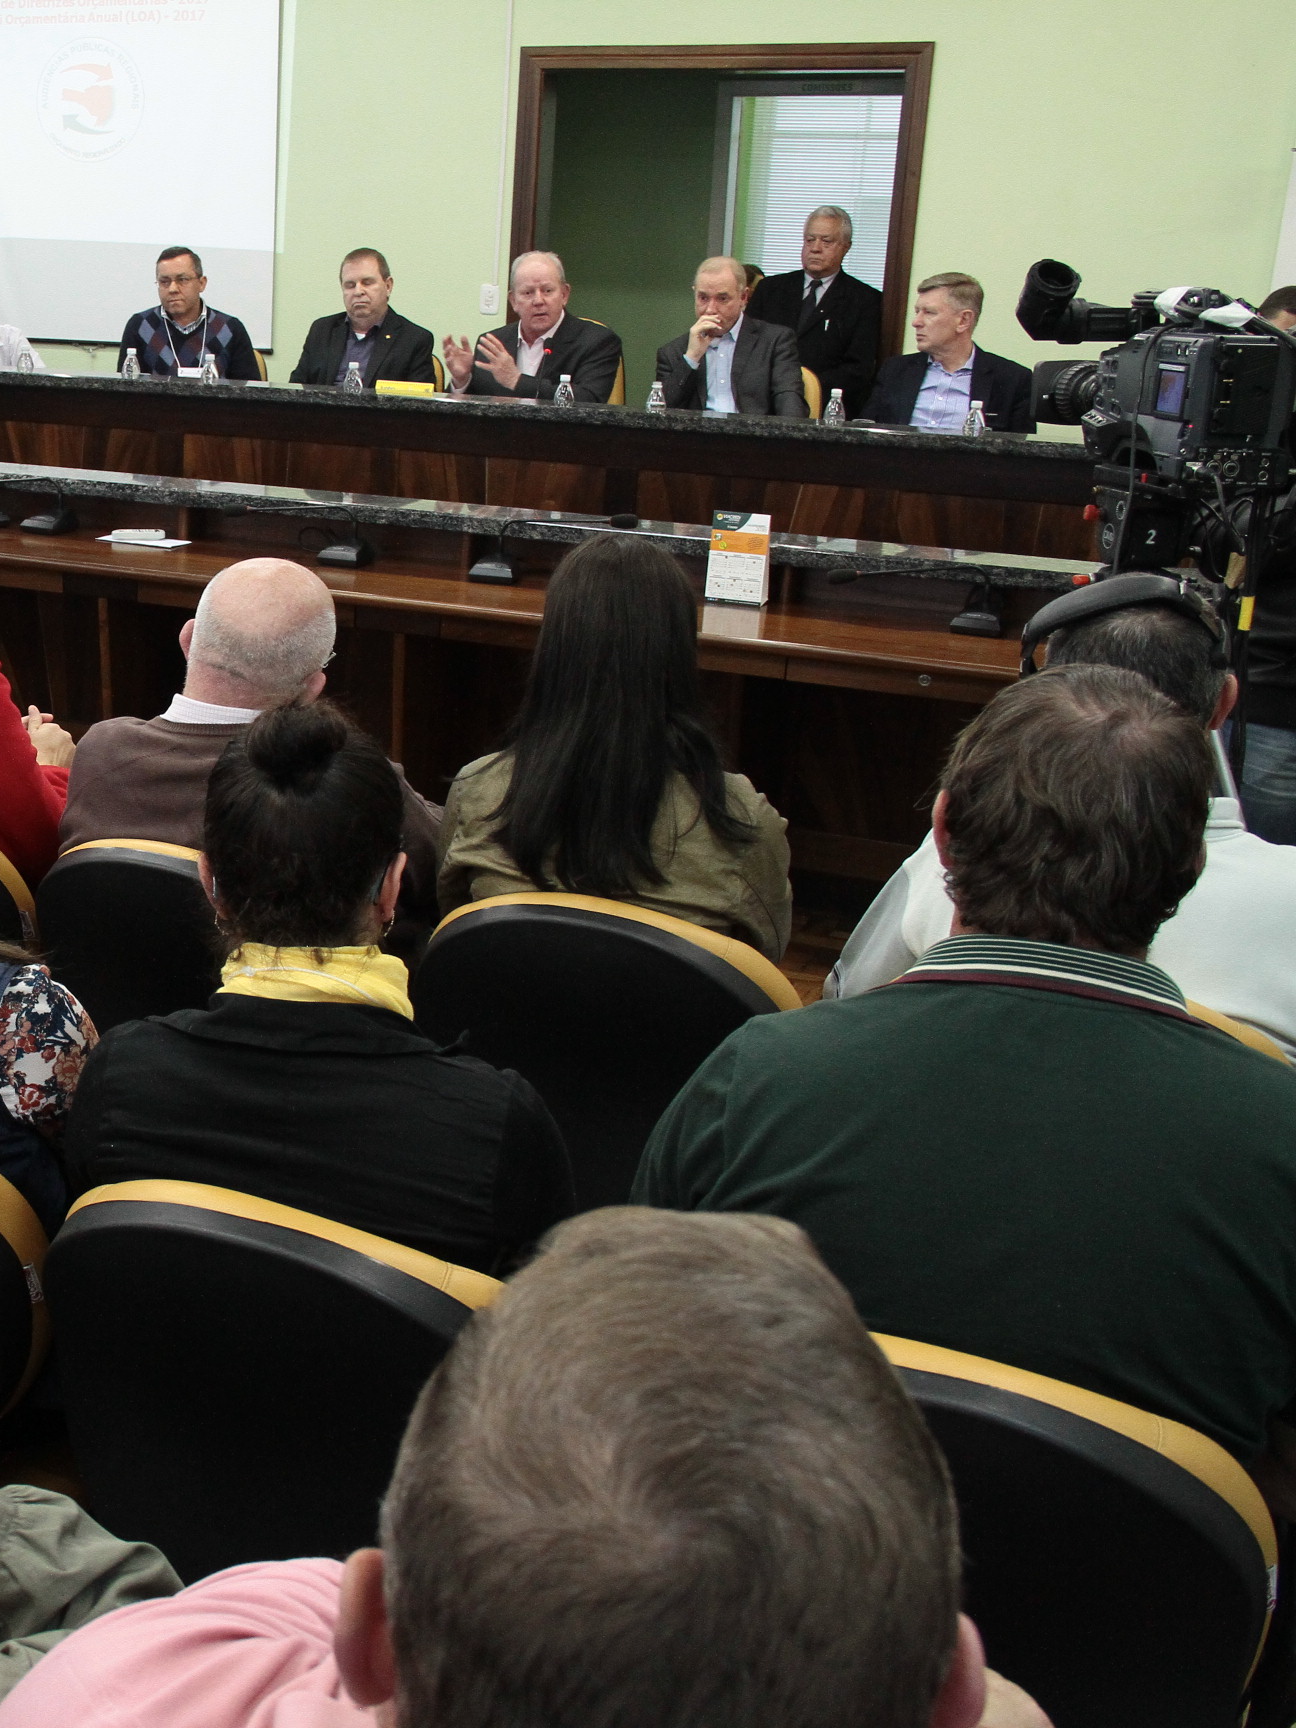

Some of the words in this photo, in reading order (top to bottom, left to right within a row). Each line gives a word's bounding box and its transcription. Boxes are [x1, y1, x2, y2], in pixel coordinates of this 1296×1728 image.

[88, 10, 123, 23] Anual
[125, 9, 161, 25] (LOA)
[173, 9, 205, 21] 2017
[1145, 529, 1157, 545] 2
